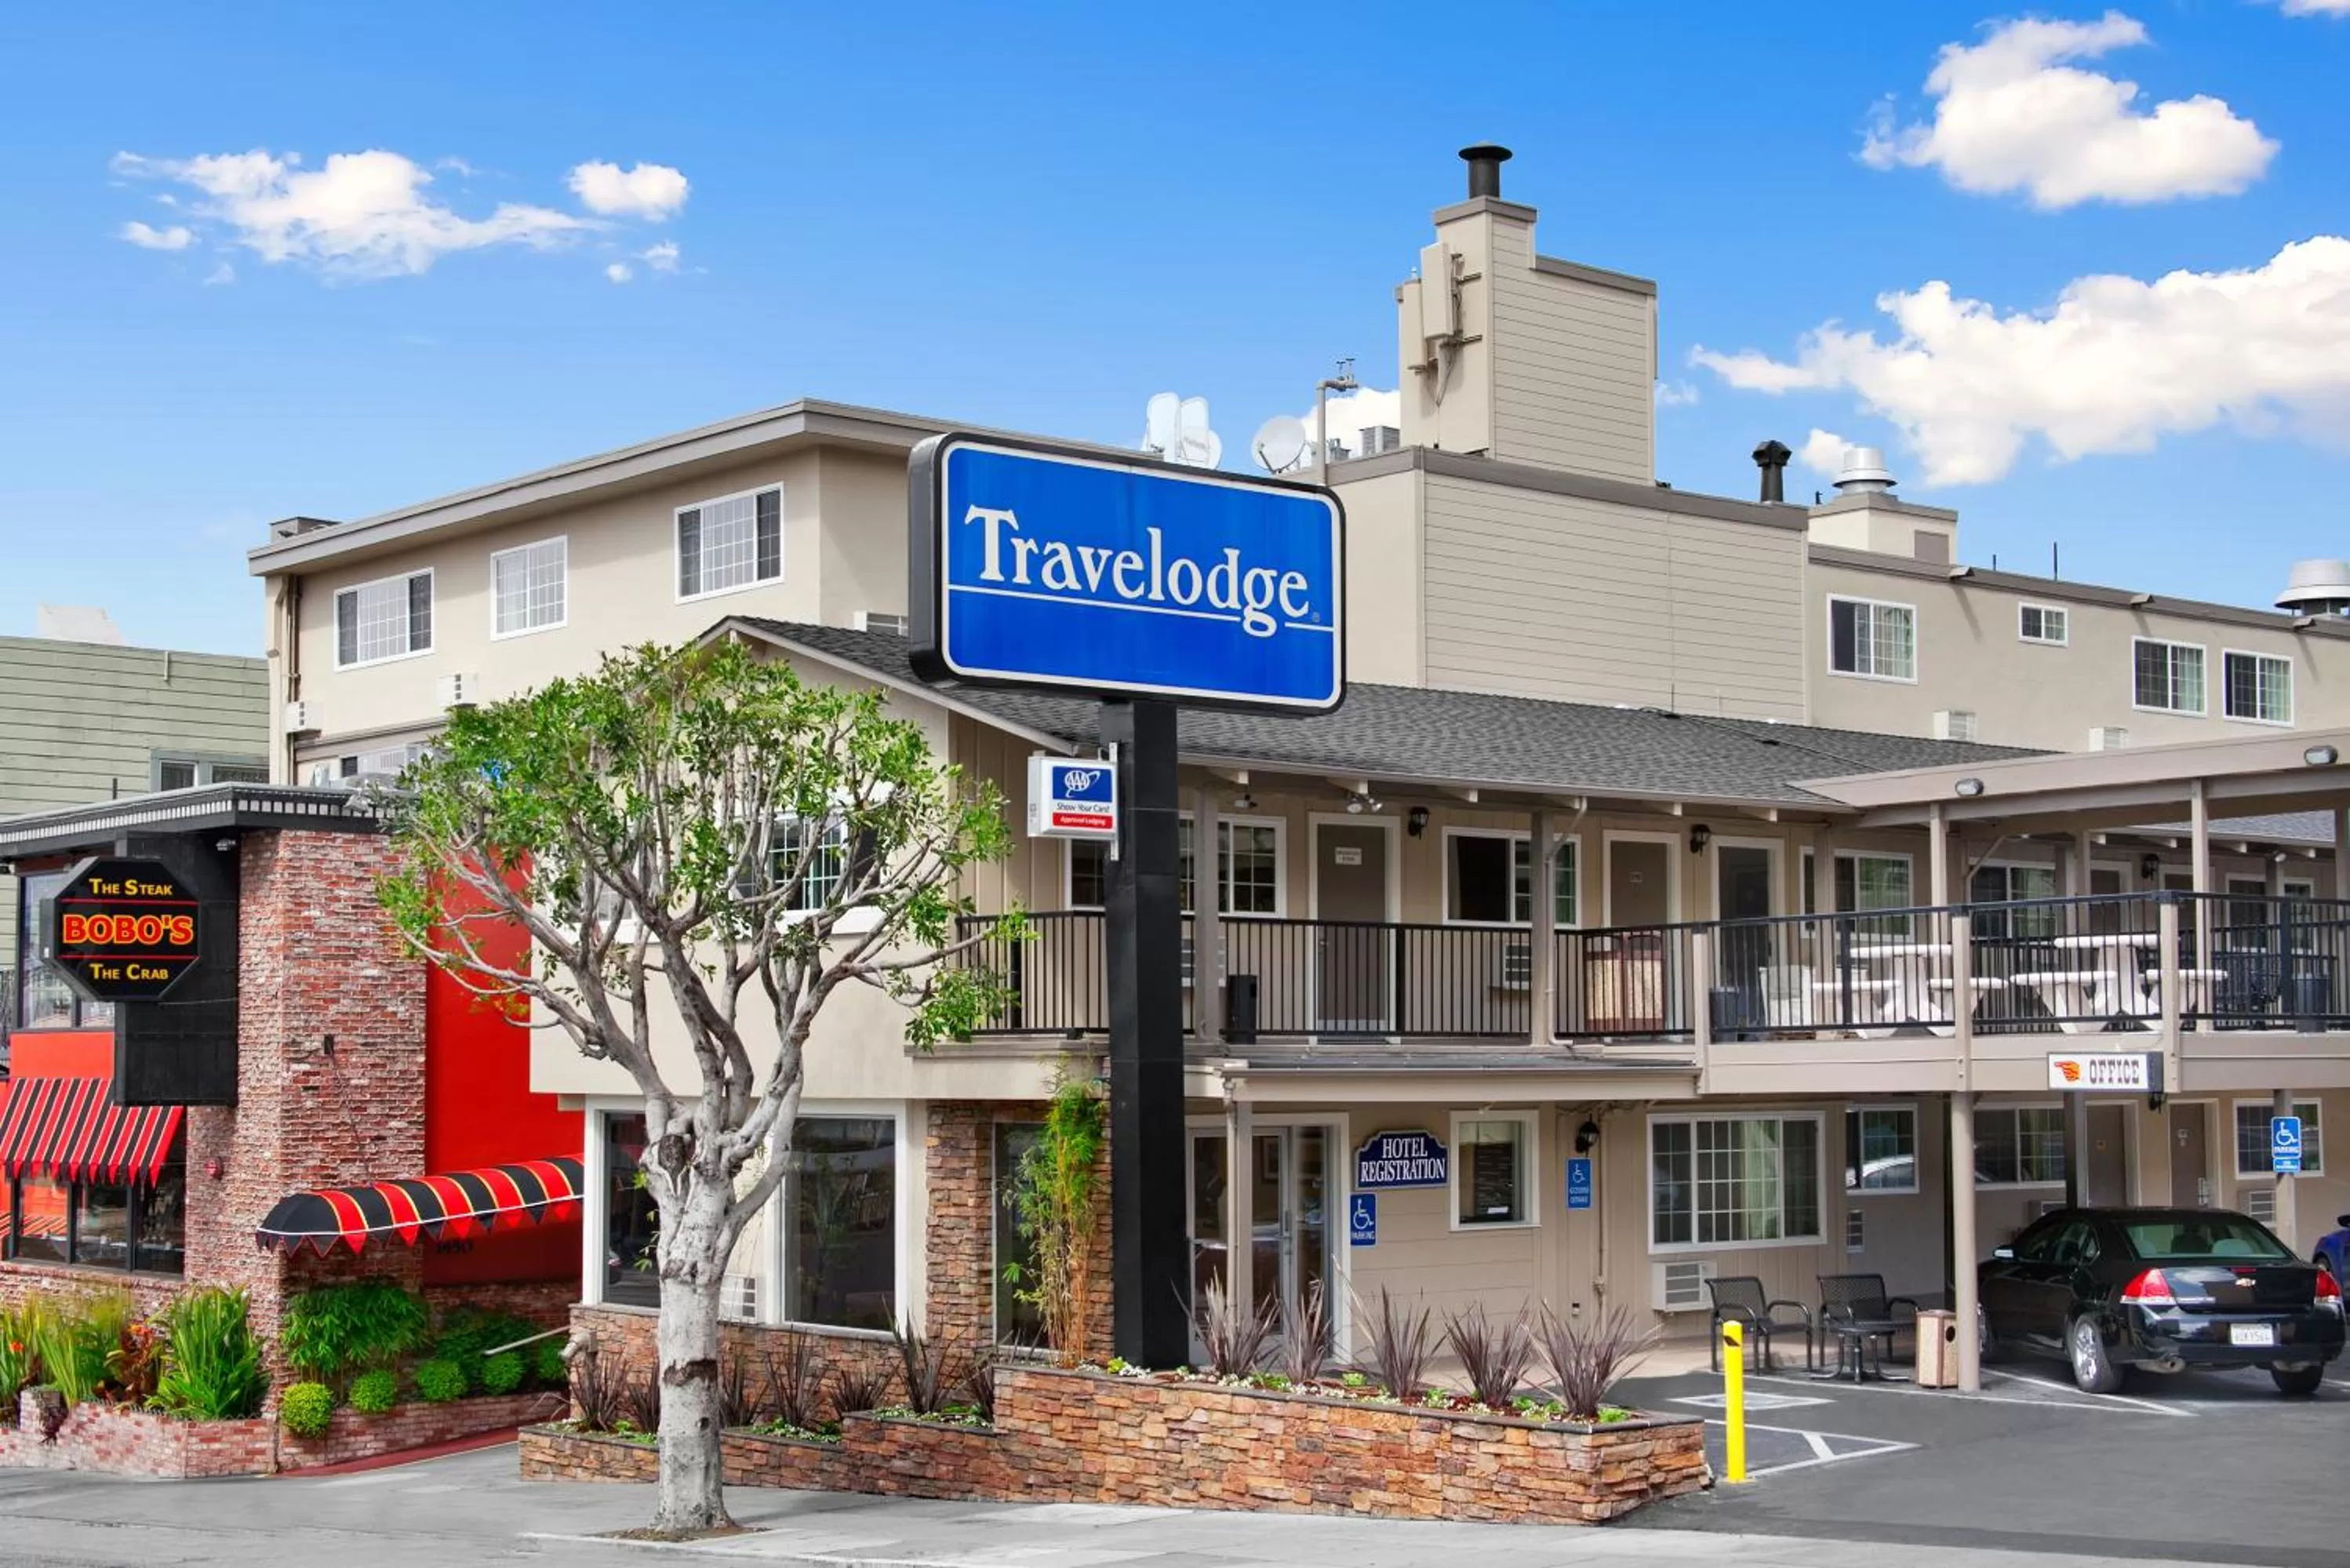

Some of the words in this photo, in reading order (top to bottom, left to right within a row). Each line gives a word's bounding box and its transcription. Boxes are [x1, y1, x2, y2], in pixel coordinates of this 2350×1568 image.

[965, 504, 1309, 637] Travelodge
[1093, 804, 1110, 813] Card
[63, 914, 194, 945] BOBO'S
[2089, 1058, 2140, 1085] OFFICE
[1381, 1137, 1428, 1159] HOTEL
[1360, 1157, 1446, 1182] REGISTRATION
